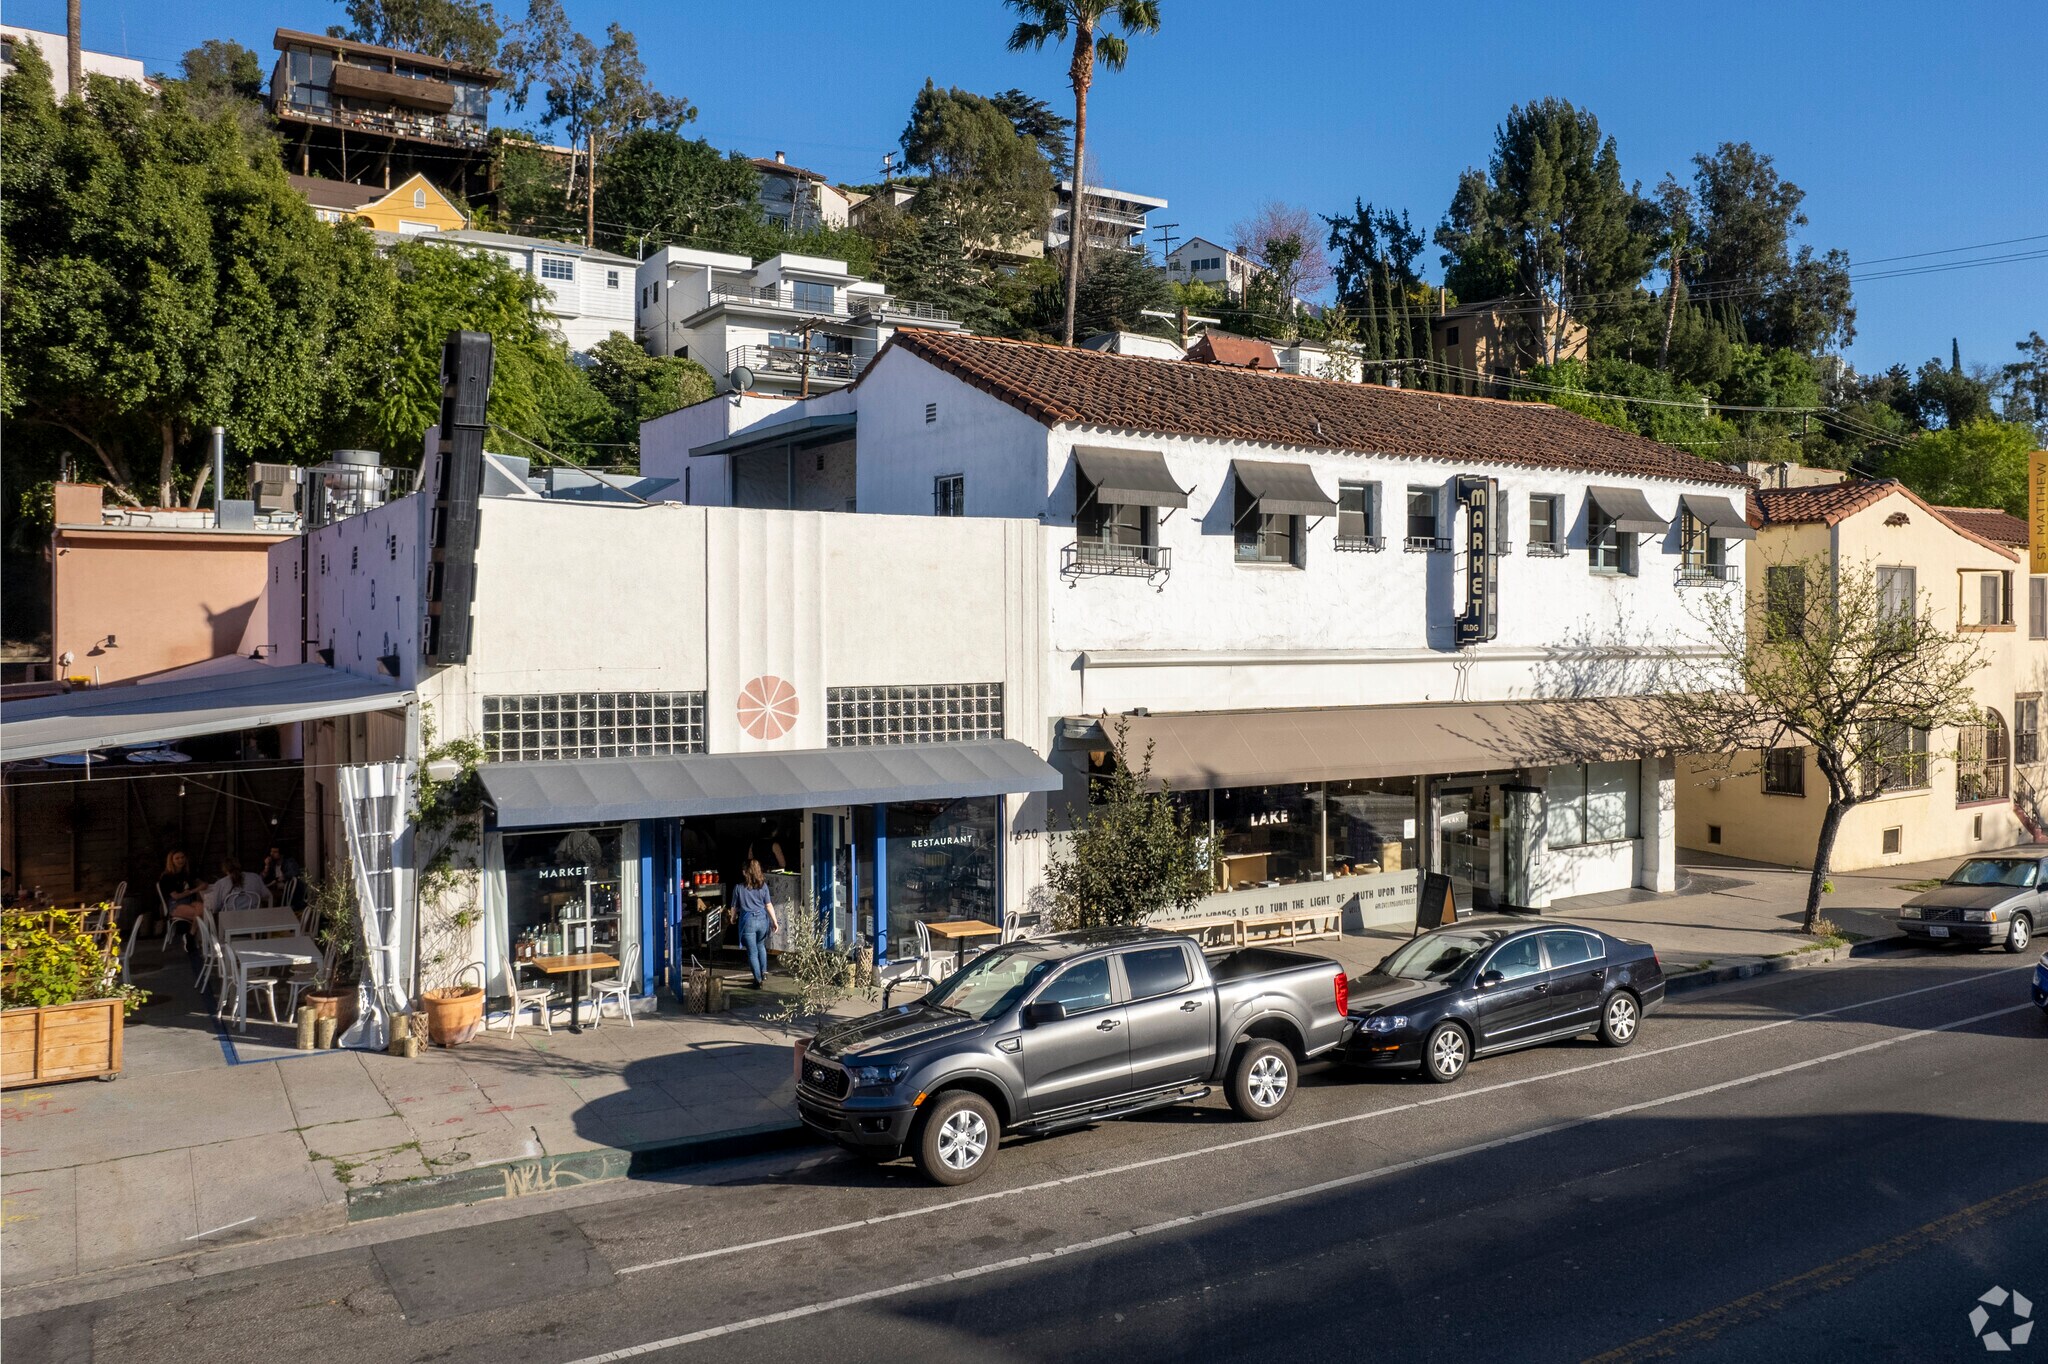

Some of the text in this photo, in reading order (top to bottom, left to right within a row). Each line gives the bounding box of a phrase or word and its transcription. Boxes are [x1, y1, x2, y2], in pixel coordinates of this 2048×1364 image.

[2037, 462, 2046, 560] ST. MATTHEW
[1471, 488, 1486, 617] MARKET
[1463, 624, 1479, 632] BLDG
[1250, 809, 1289, 826] LAKE
[910, 834, 973, 849] RESTAURANT
[1009, 828, 1038, 842] 1620
[539, 866, 589, 879] MARKET
[1241, 907, 1249, 916] IS
[1255, 905, 1264, 914] TO
[1270, 901, 1288, 913] TURN
[1292, 900, 1304, 910] THE
[1310, 895, 1330, 907] LIGHT
[1336, 893, 1346, 903] OF
[1353, 889, 1374, 901] TRUTH
[1377, 886, 1395, 898] UPON
[1400, 884, 1418, 895] THEM
